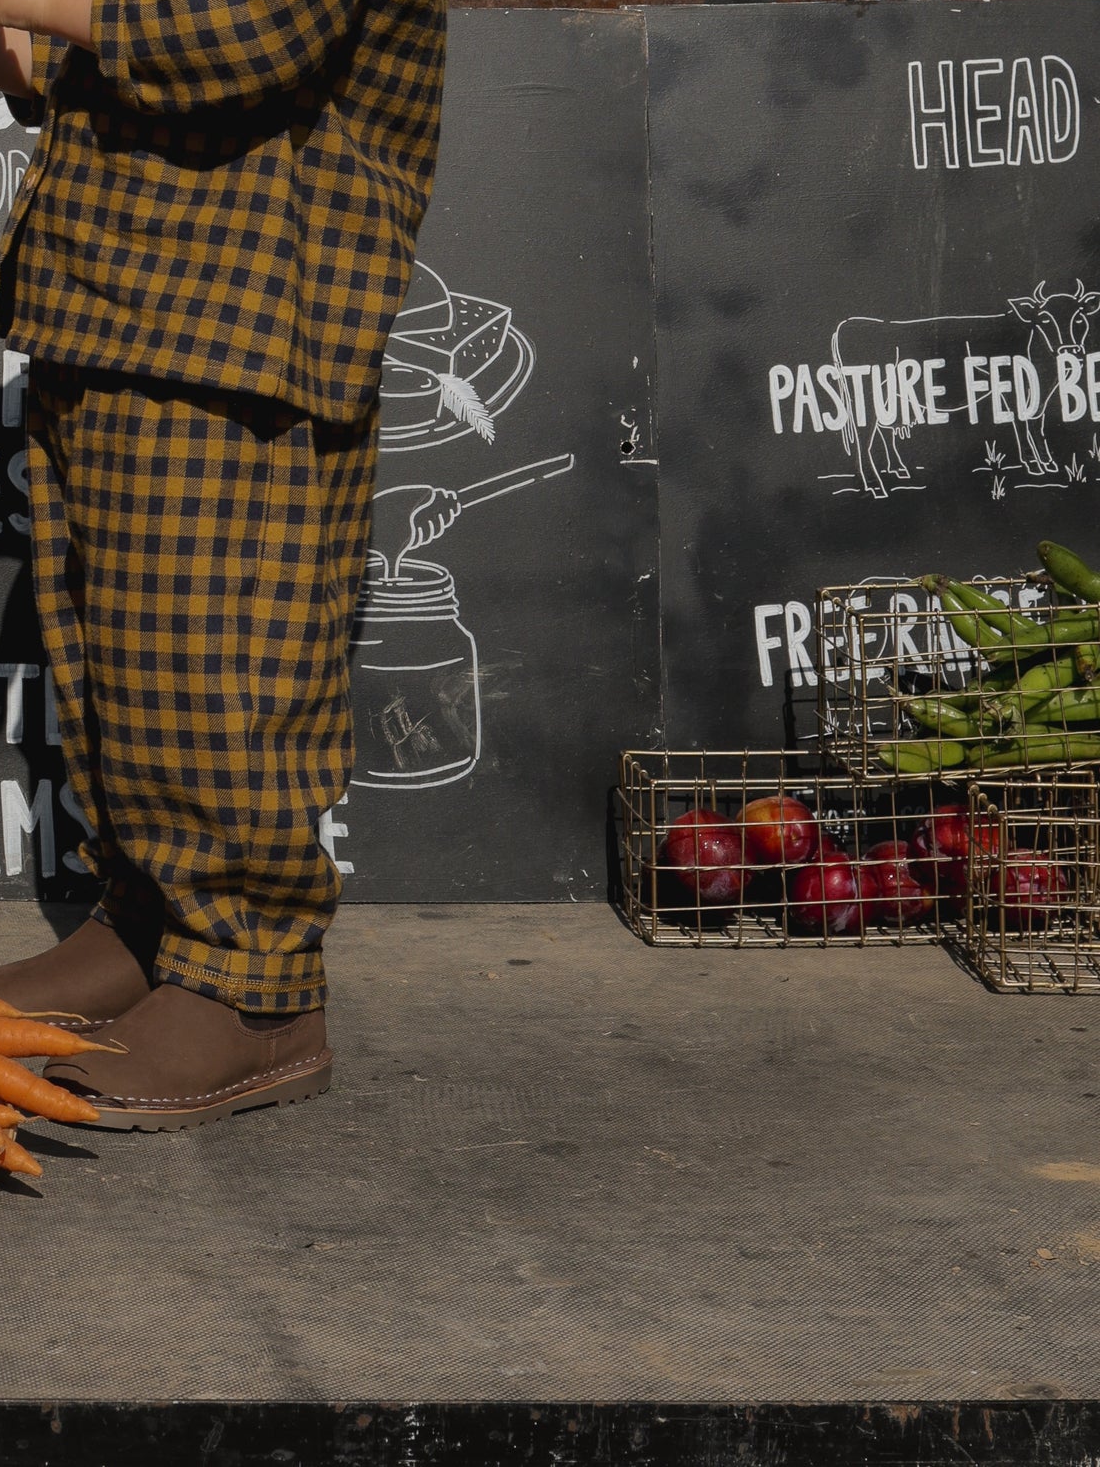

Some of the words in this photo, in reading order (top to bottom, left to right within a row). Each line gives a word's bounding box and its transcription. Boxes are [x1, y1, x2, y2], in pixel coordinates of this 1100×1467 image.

[908, 55, 1081, 169] HEAD
[768, 357, 950, 435] PASTURE
[963, 354, 1041, 425] FED
[754, 594, 887, 688] FREE
